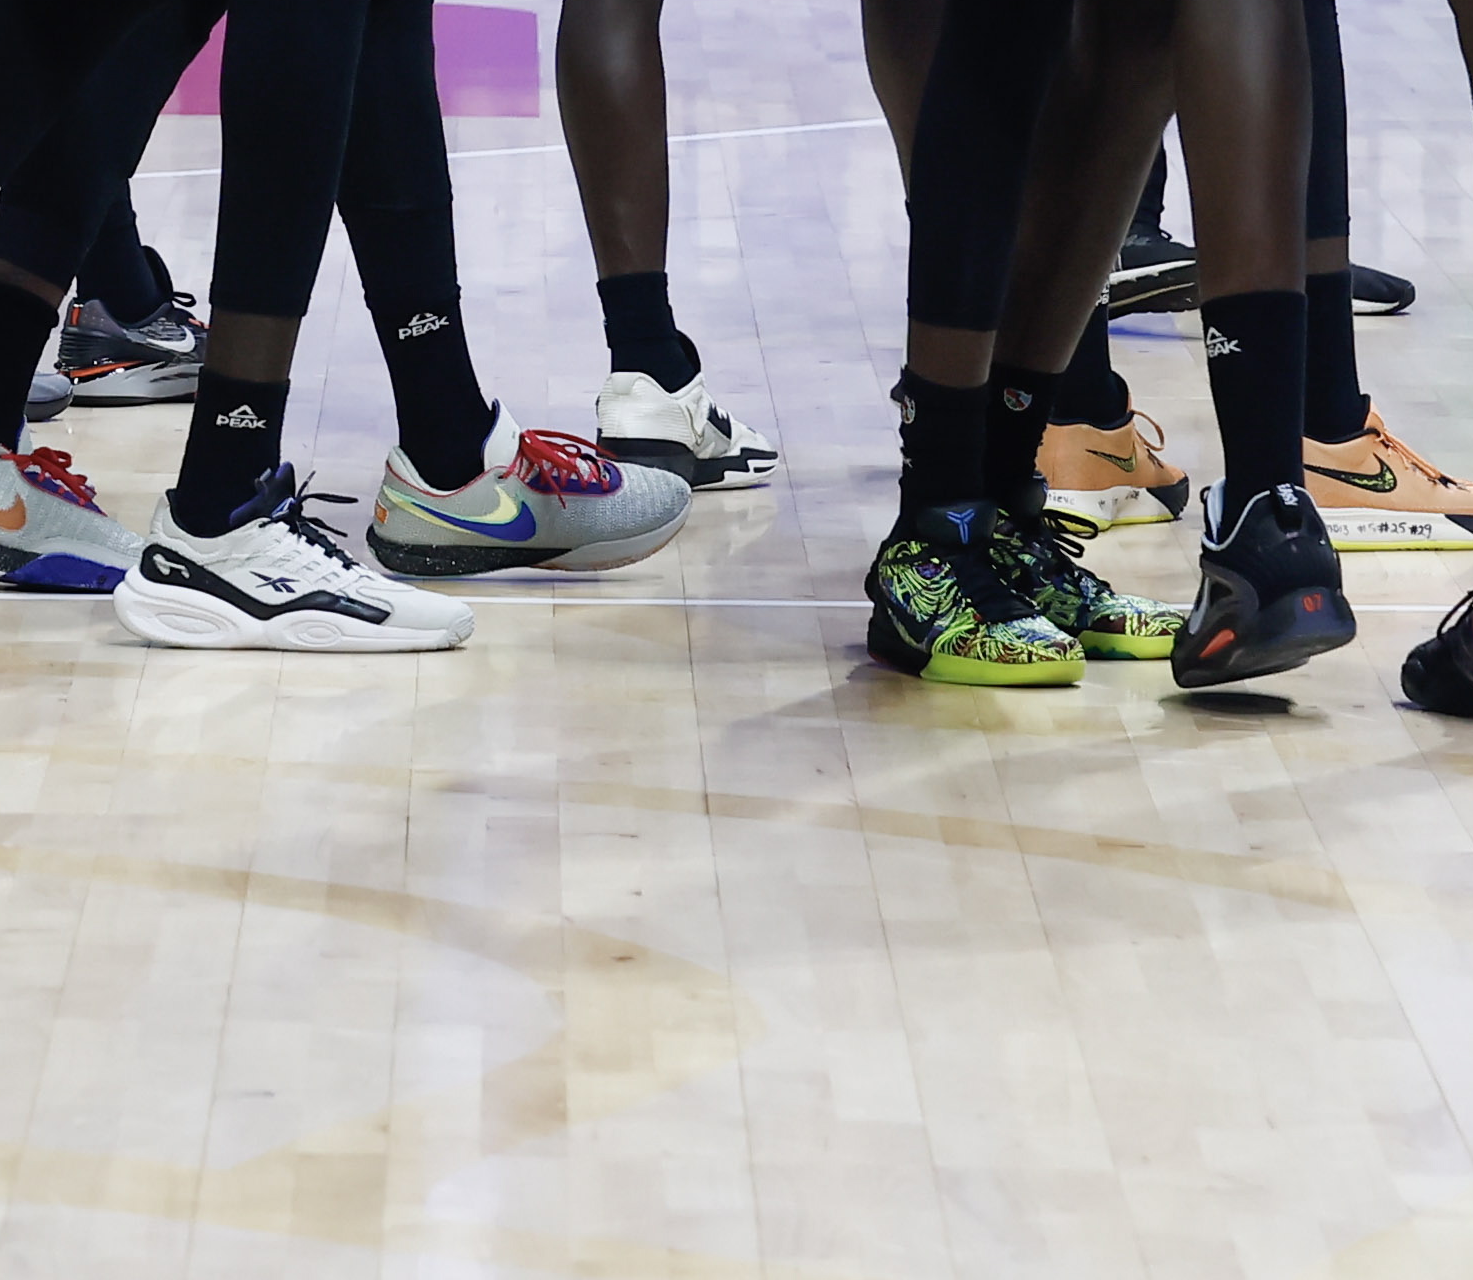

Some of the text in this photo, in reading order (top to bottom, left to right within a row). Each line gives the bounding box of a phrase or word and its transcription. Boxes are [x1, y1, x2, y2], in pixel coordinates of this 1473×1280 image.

[398, 316, 450, 340] PEAK
[1208, 339, 1242, 358] EAK
[216, 414, 268, 430] PEAK
